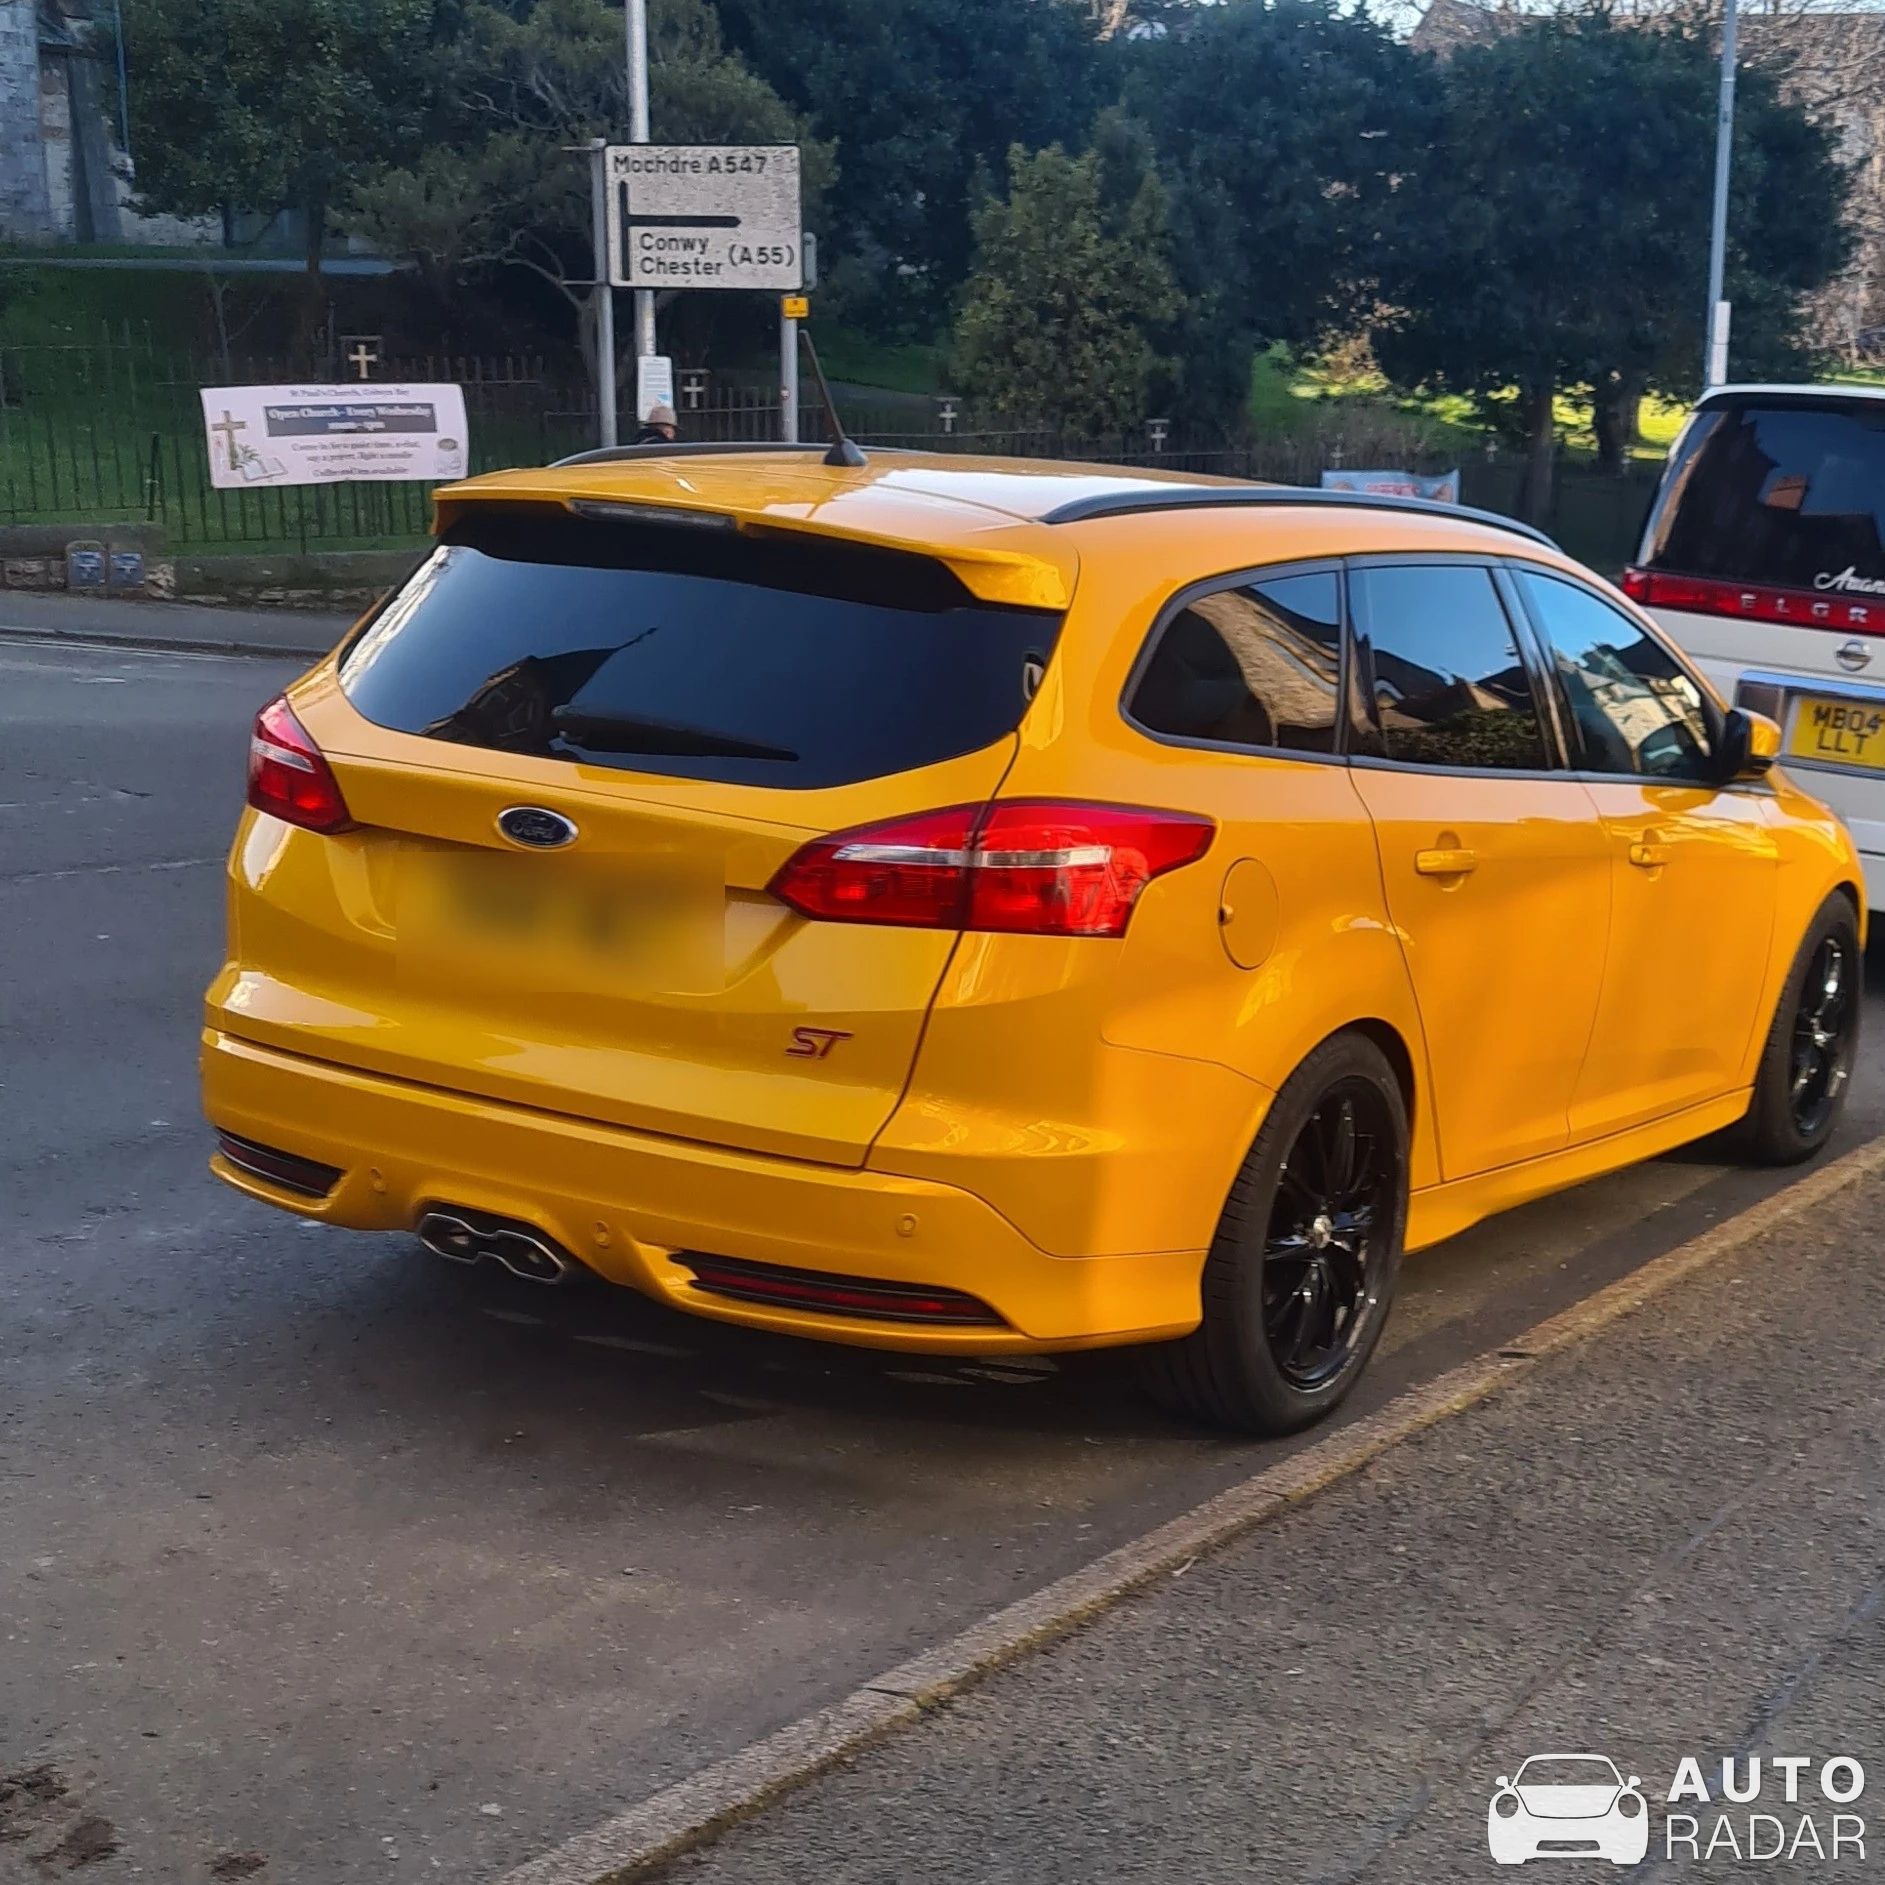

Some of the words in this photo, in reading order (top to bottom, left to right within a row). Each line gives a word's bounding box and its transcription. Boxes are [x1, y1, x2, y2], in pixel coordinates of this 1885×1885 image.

[613, 155, 701, 174] Mochdre
[708, 155, 767, 174] A547
[639, 232, 709, 255] Conwy
[728, 243, 795, 267] (A55)
[639, 256, 722, 275] Chester
[1813, 704, 1884, 735] MB04
[1816, 727, 1869, 755] LLT
[785, 1026, 854, 1059] ST
